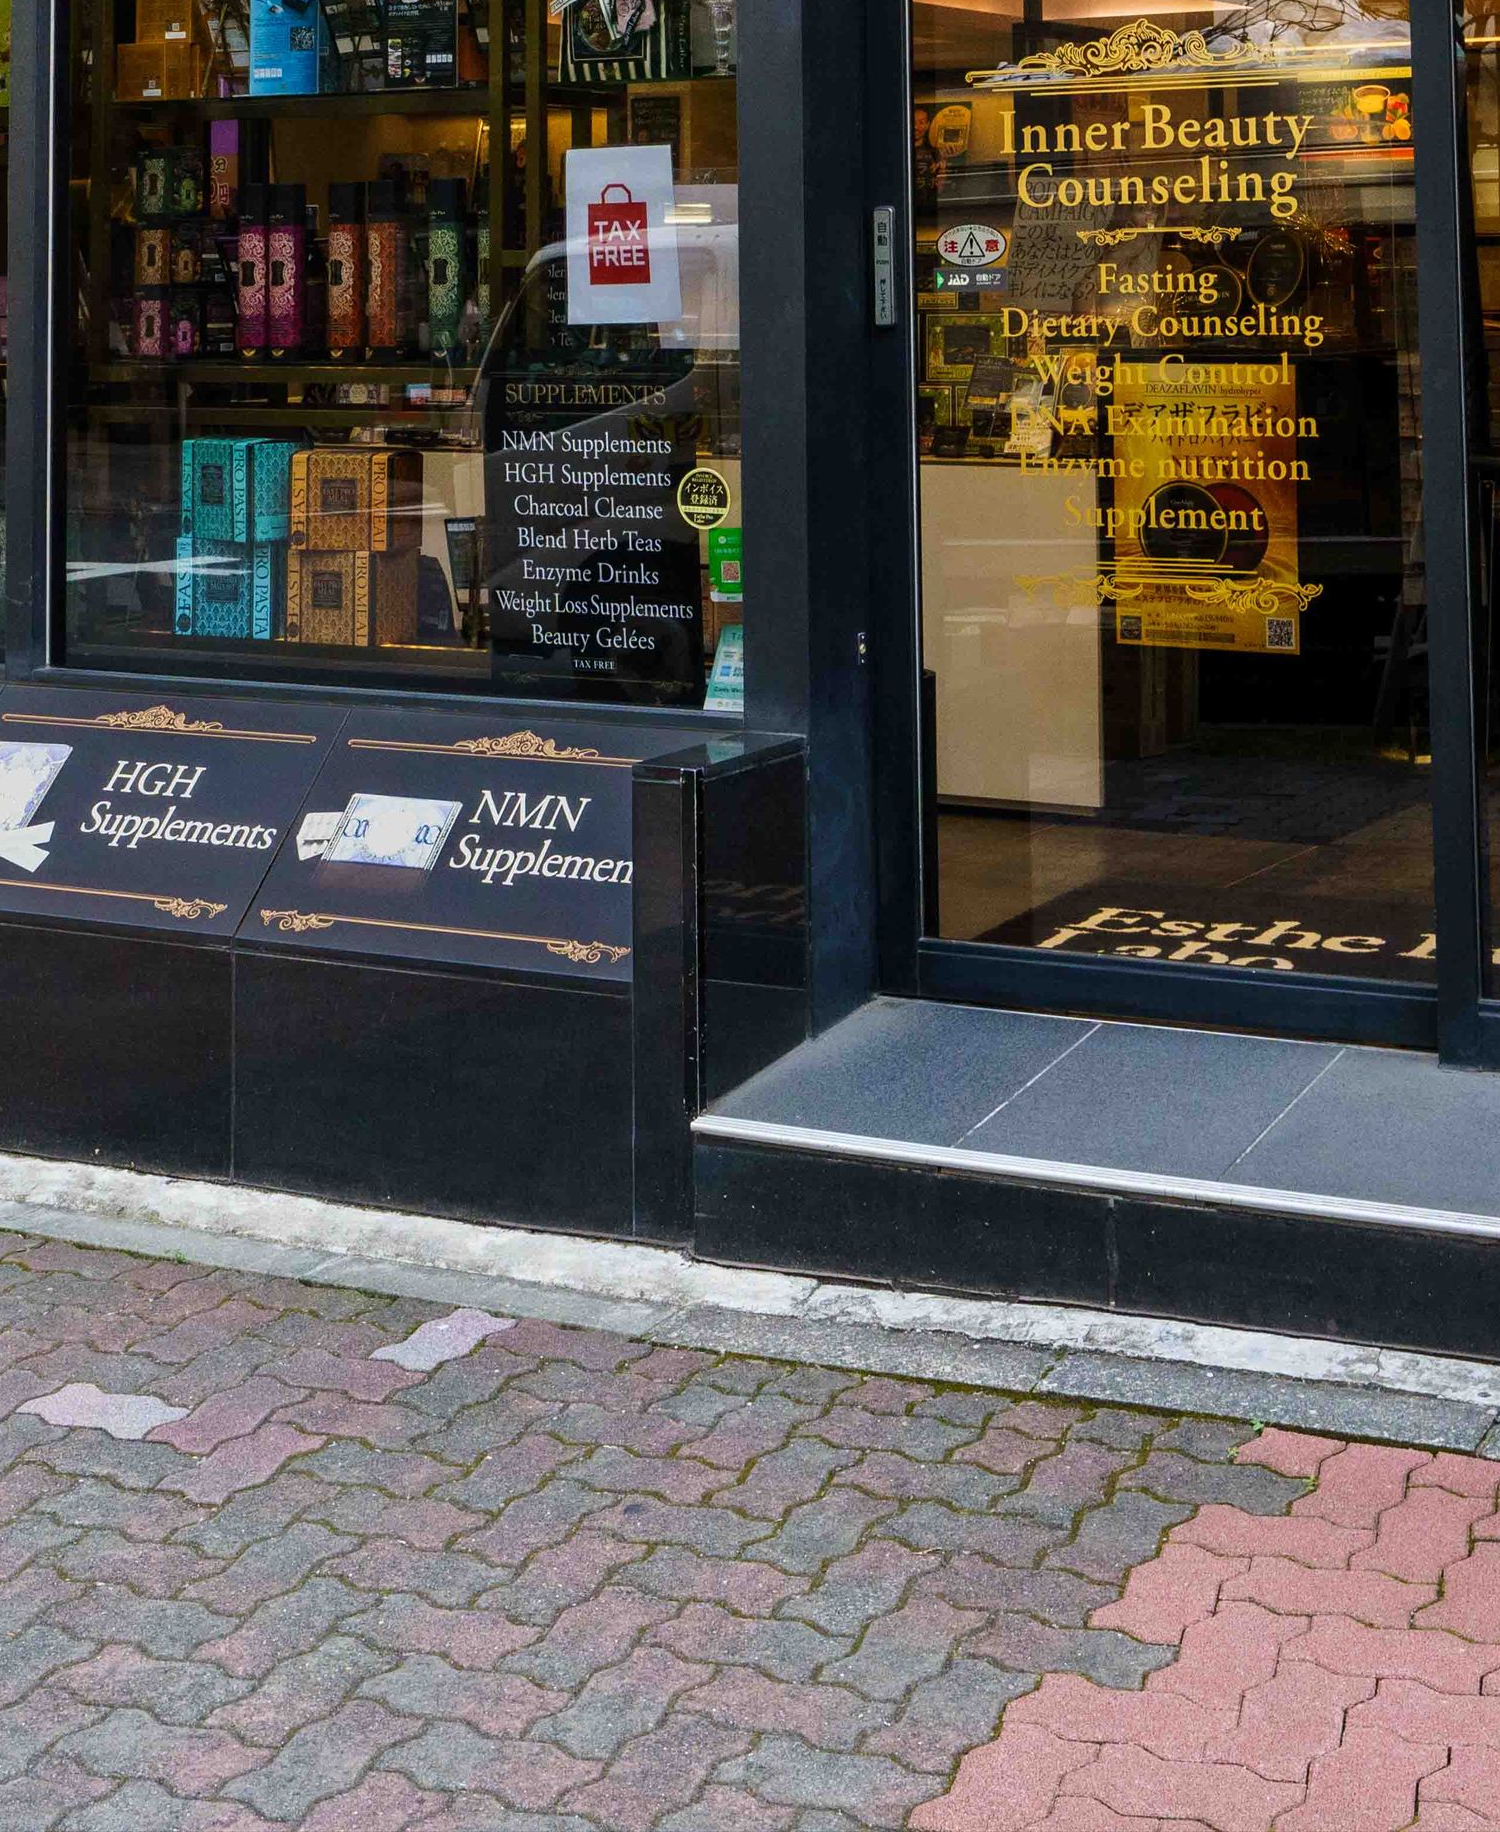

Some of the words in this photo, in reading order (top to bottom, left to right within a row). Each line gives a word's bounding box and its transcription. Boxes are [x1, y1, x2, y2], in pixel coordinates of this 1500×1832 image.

[999, 110, 1131, 156] Inner
[1140, 104, 1315, 160] Beauty
[1017, 158, 1299, 217] Counseling
[594, 219, 642, 242] TAX
[944, 239, 958, 253] 注
[985, 239, 1000, 253] 意
[592, 243, 646, 268] FREE
[947, 274, 970, 286] JAD
[976, 273, 1001, 283] 自動ドア
[1097, 263, 1219, 304] Fasting
[1000, 306, 1122, 346] Dietary
[1131, 304, 1325, 348] Counseling
[1031, 353, 1150, 397] Weight
[1157, 351, 1292, 387] Control
[504, 381, 667, 406] SUPPLEMENTS
[1009, 402, 1095, 436] DNA
[1105, 397, 1320, 439] Examination
[501, 428, 556, 454] NMN
[561, 430, 672, 460] Supplements
[504, 461, 555, 486] HGH
[561, 462, 672, 492] Supplements
[1018, 448, 1146, 488] Enzyme
[1156, 449, 1311, 481] nutrition
[684, 483, 724, 495] インボイス
[690, 495, 718, 506] 登録済
[234, 488, 246, 537] PASTA
[513, 494, 590, 519] Charcoal
[593, 495, 664, 520] Cleanse
[1063, 495, 1265, 538] Supplement
[516, 526, 571, 551] Blend
[572, 527, 617, 552] Herb
[620, 528, 663, 553] Teas
[522, 559, 593, 589] Enzyme
[595, 560, 660, 586] Drinks
[255, 583, 269, 638] PASTA
[496, 589, 553, 619] Weight
[553, 591, 589, 616] Loss
[589, 593, 694, 621] Supplements
[530, 624, 592, 654] Beauty
[595, 625, 656, 651] Gelées
[573, 658, 592, 669] TAX
[593, 658, 616, 670] FREE
[101, 759, 208, 800] HGH
[79, 801, 280, 852] Supplements
[467, 789, 597, 835] NMN
[448, 834, 633, 887] Supplemen
[1066, 905, 1387, 956] Esthe
